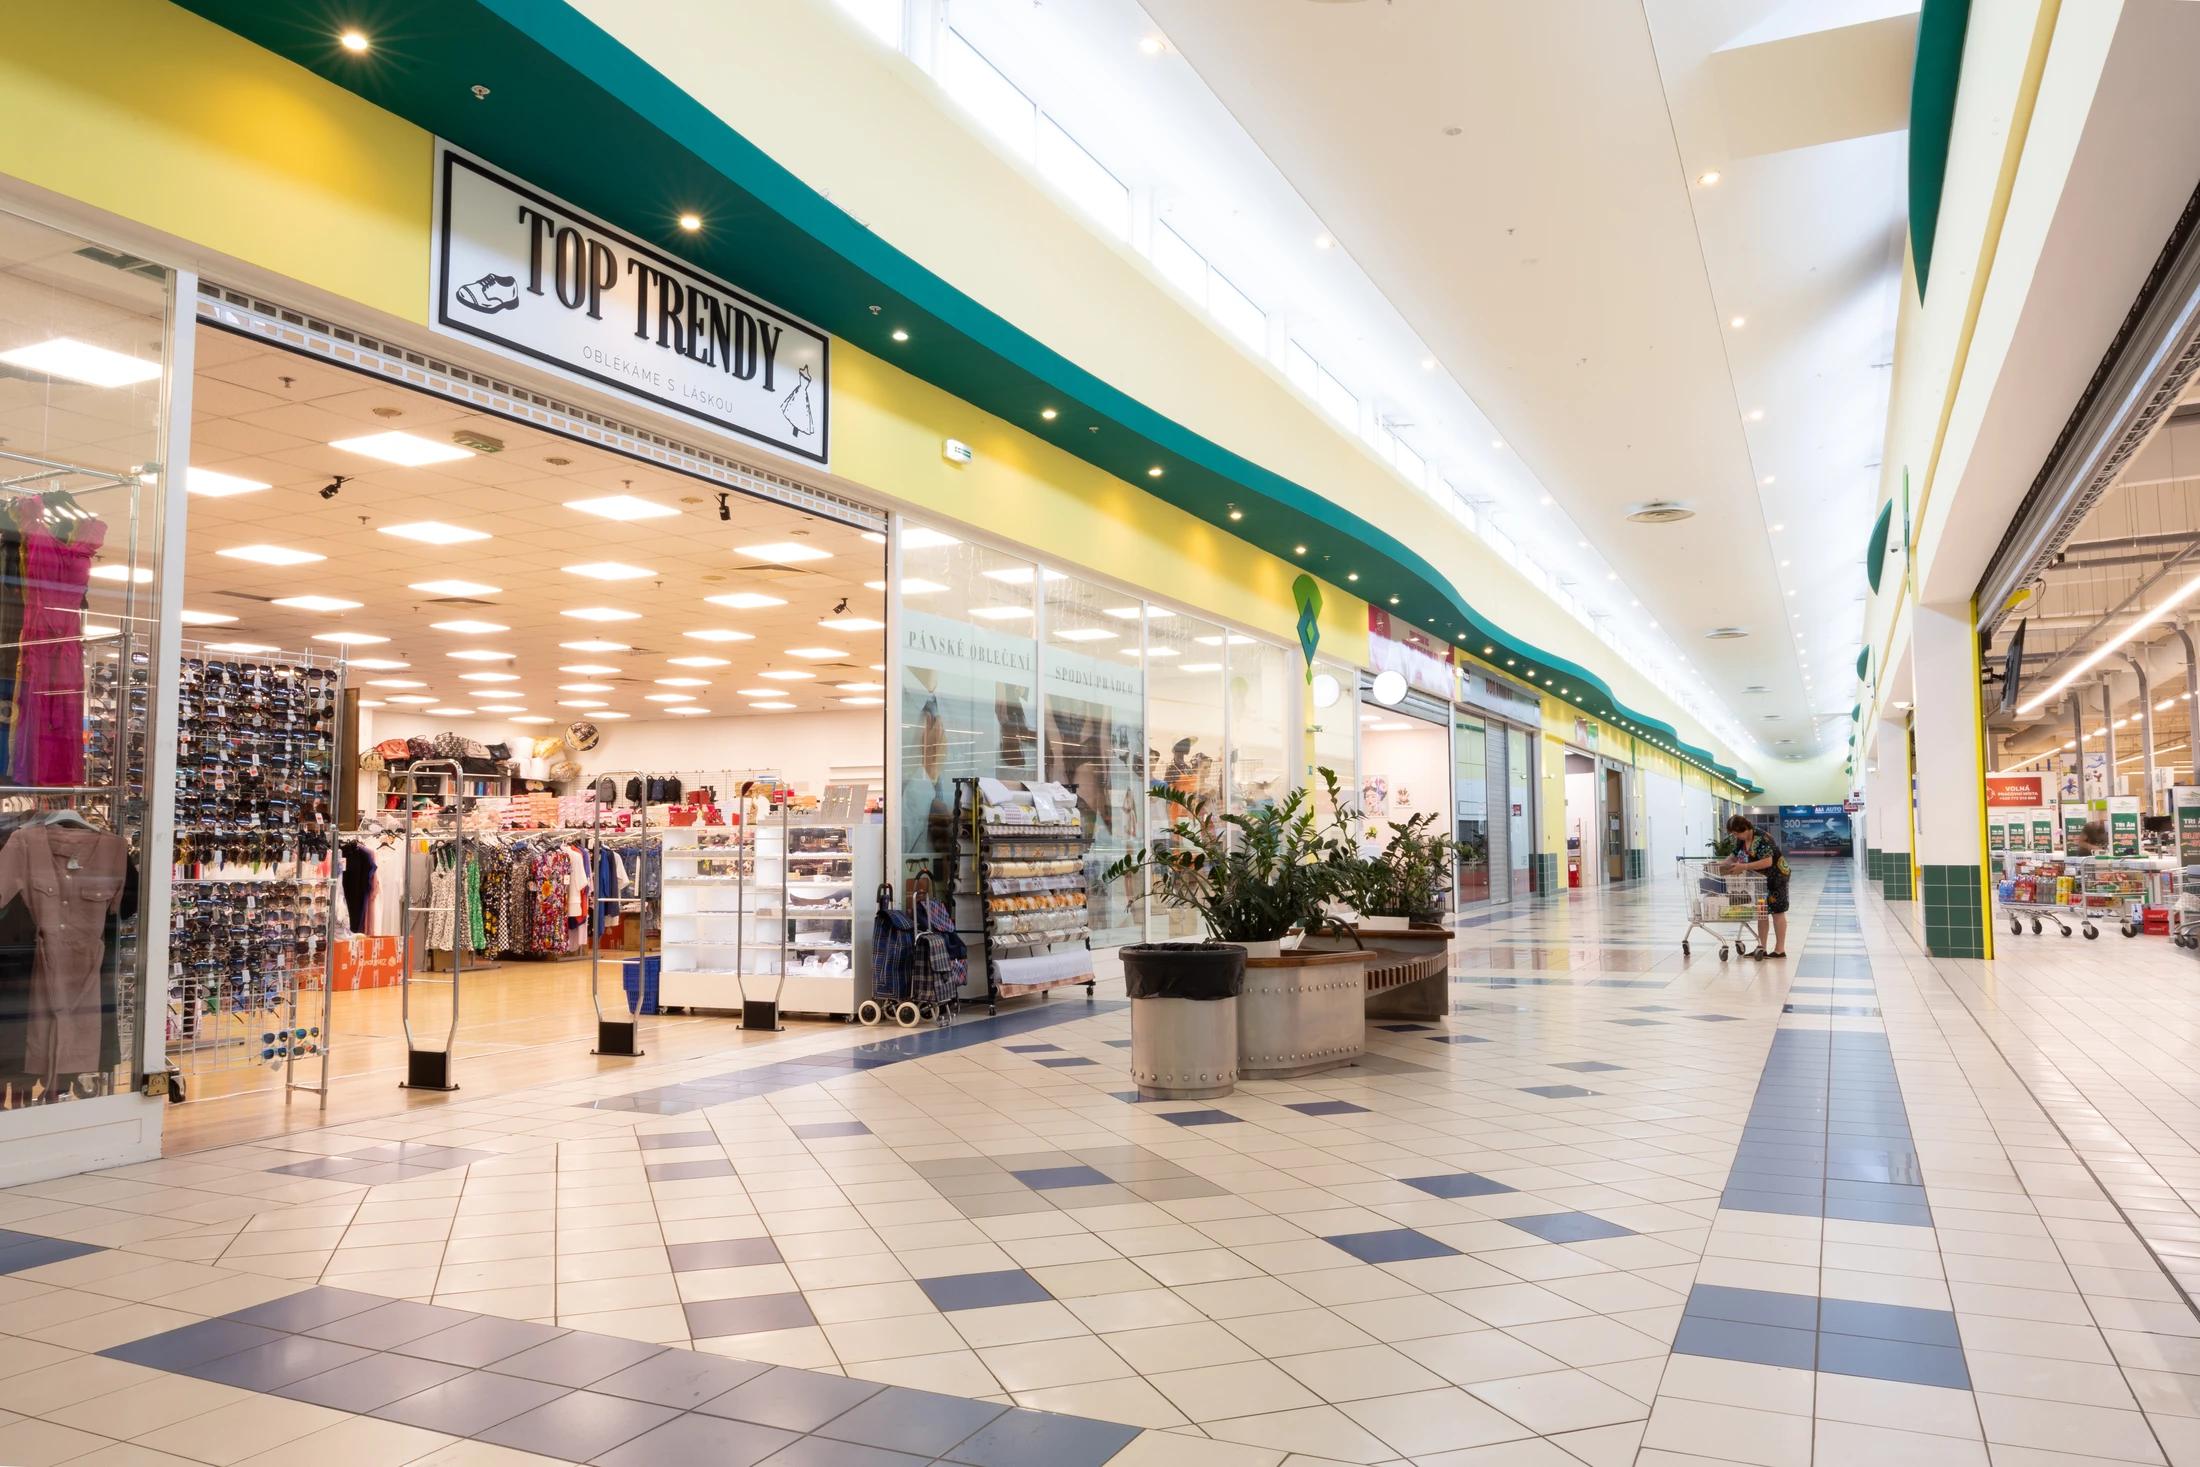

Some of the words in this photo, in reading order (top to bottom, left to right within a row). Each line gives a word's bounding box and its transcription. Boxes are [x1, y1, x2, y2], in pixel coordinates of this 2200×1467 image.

[519, 205, 618, 320] TOP
[627, 257, 784, 392] TRENDY
[667, 378, 675, 392] S
[683, 383, 733, 414] LÁSKOU
[908, 629, 964, 657] PÁNSKÉ
[969, 643, 1030, 671] OBLEČENÍ
[1784, 819, 1801, 828] 300
